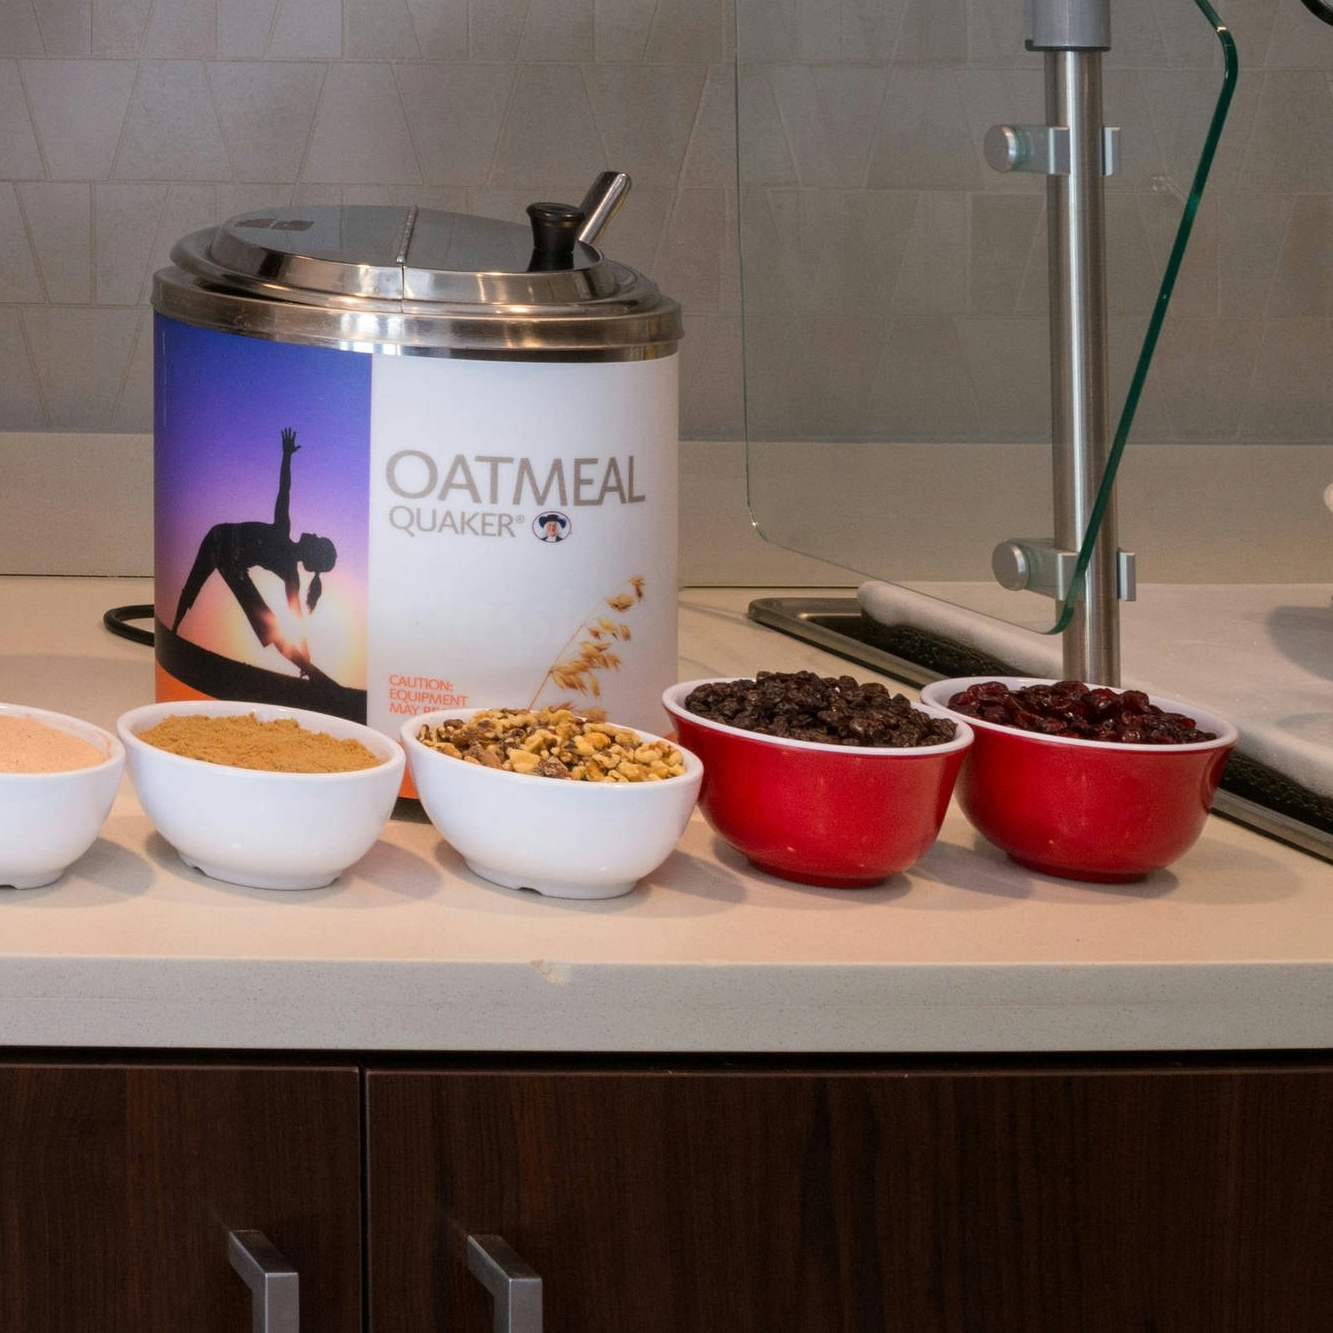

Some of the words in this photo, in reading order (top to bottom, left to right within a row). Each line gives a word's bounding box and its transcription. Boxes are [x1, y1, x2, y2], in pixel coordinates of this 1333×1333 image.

[385, 449, 646, 507] OATMEAL
[389, 505, 516, 538] QUAKER
[389, 674, 454, 692] CAUTION:
[389, 689, 469, 707] EQUIPMENT
[389, 703, 420, 716] MAY
